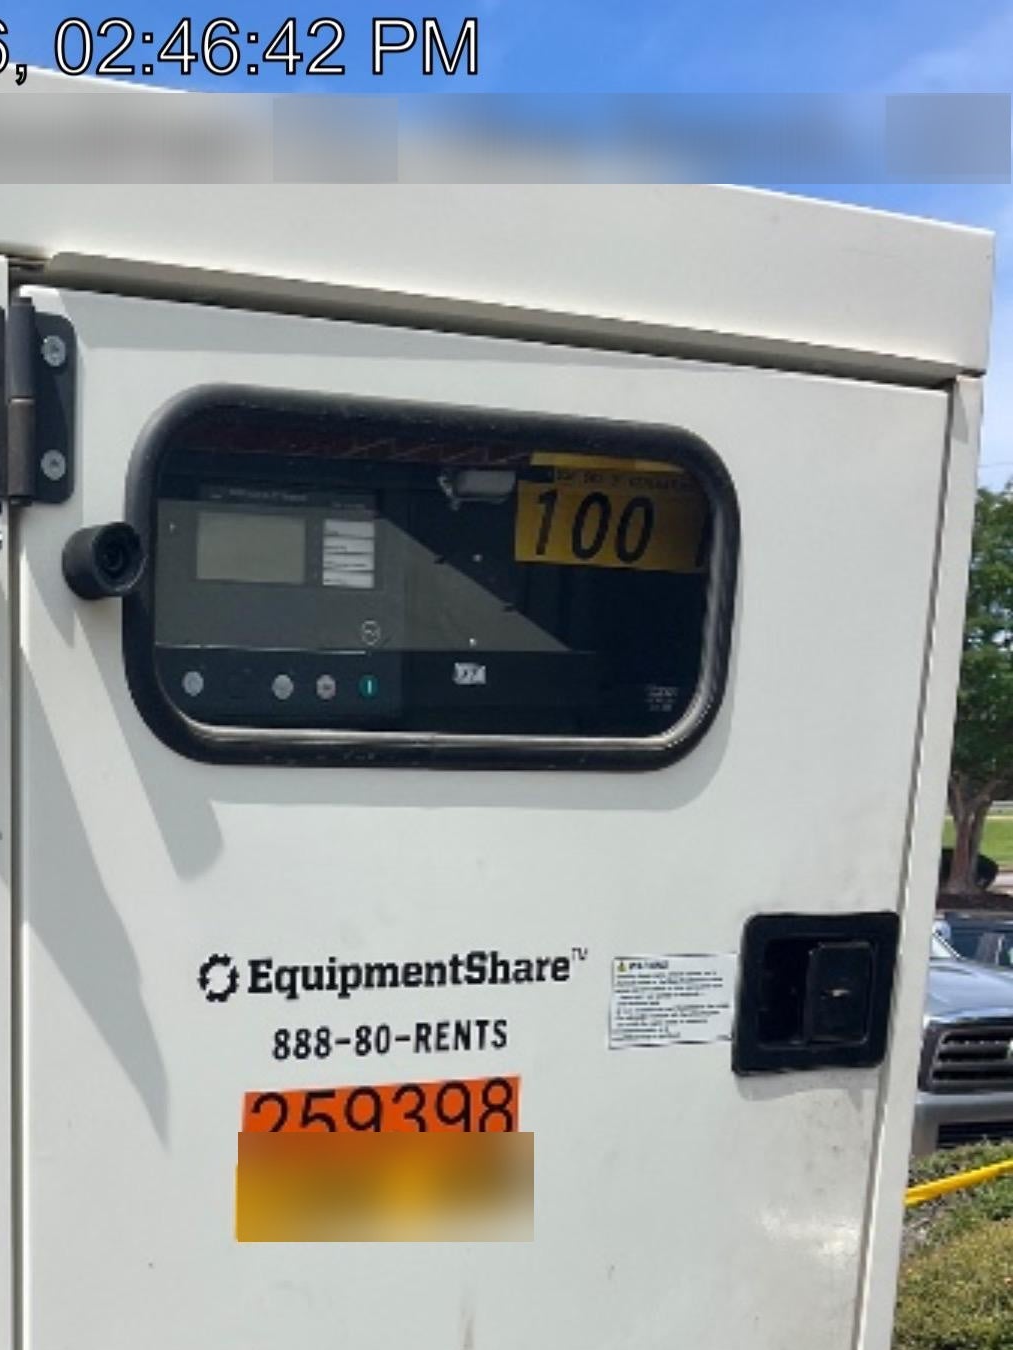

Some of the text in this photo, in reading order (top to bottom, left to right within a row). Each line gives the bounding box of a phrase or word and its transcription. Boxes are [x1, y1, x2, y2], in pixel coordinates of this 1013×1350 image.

[534, 488, 656, 564] 100
[247, 950, 571, 999] EquipmentShare
[272, 1018, 509, 1061] 888-80-RENTS
[249, 1077, 515, 1133] 259398
